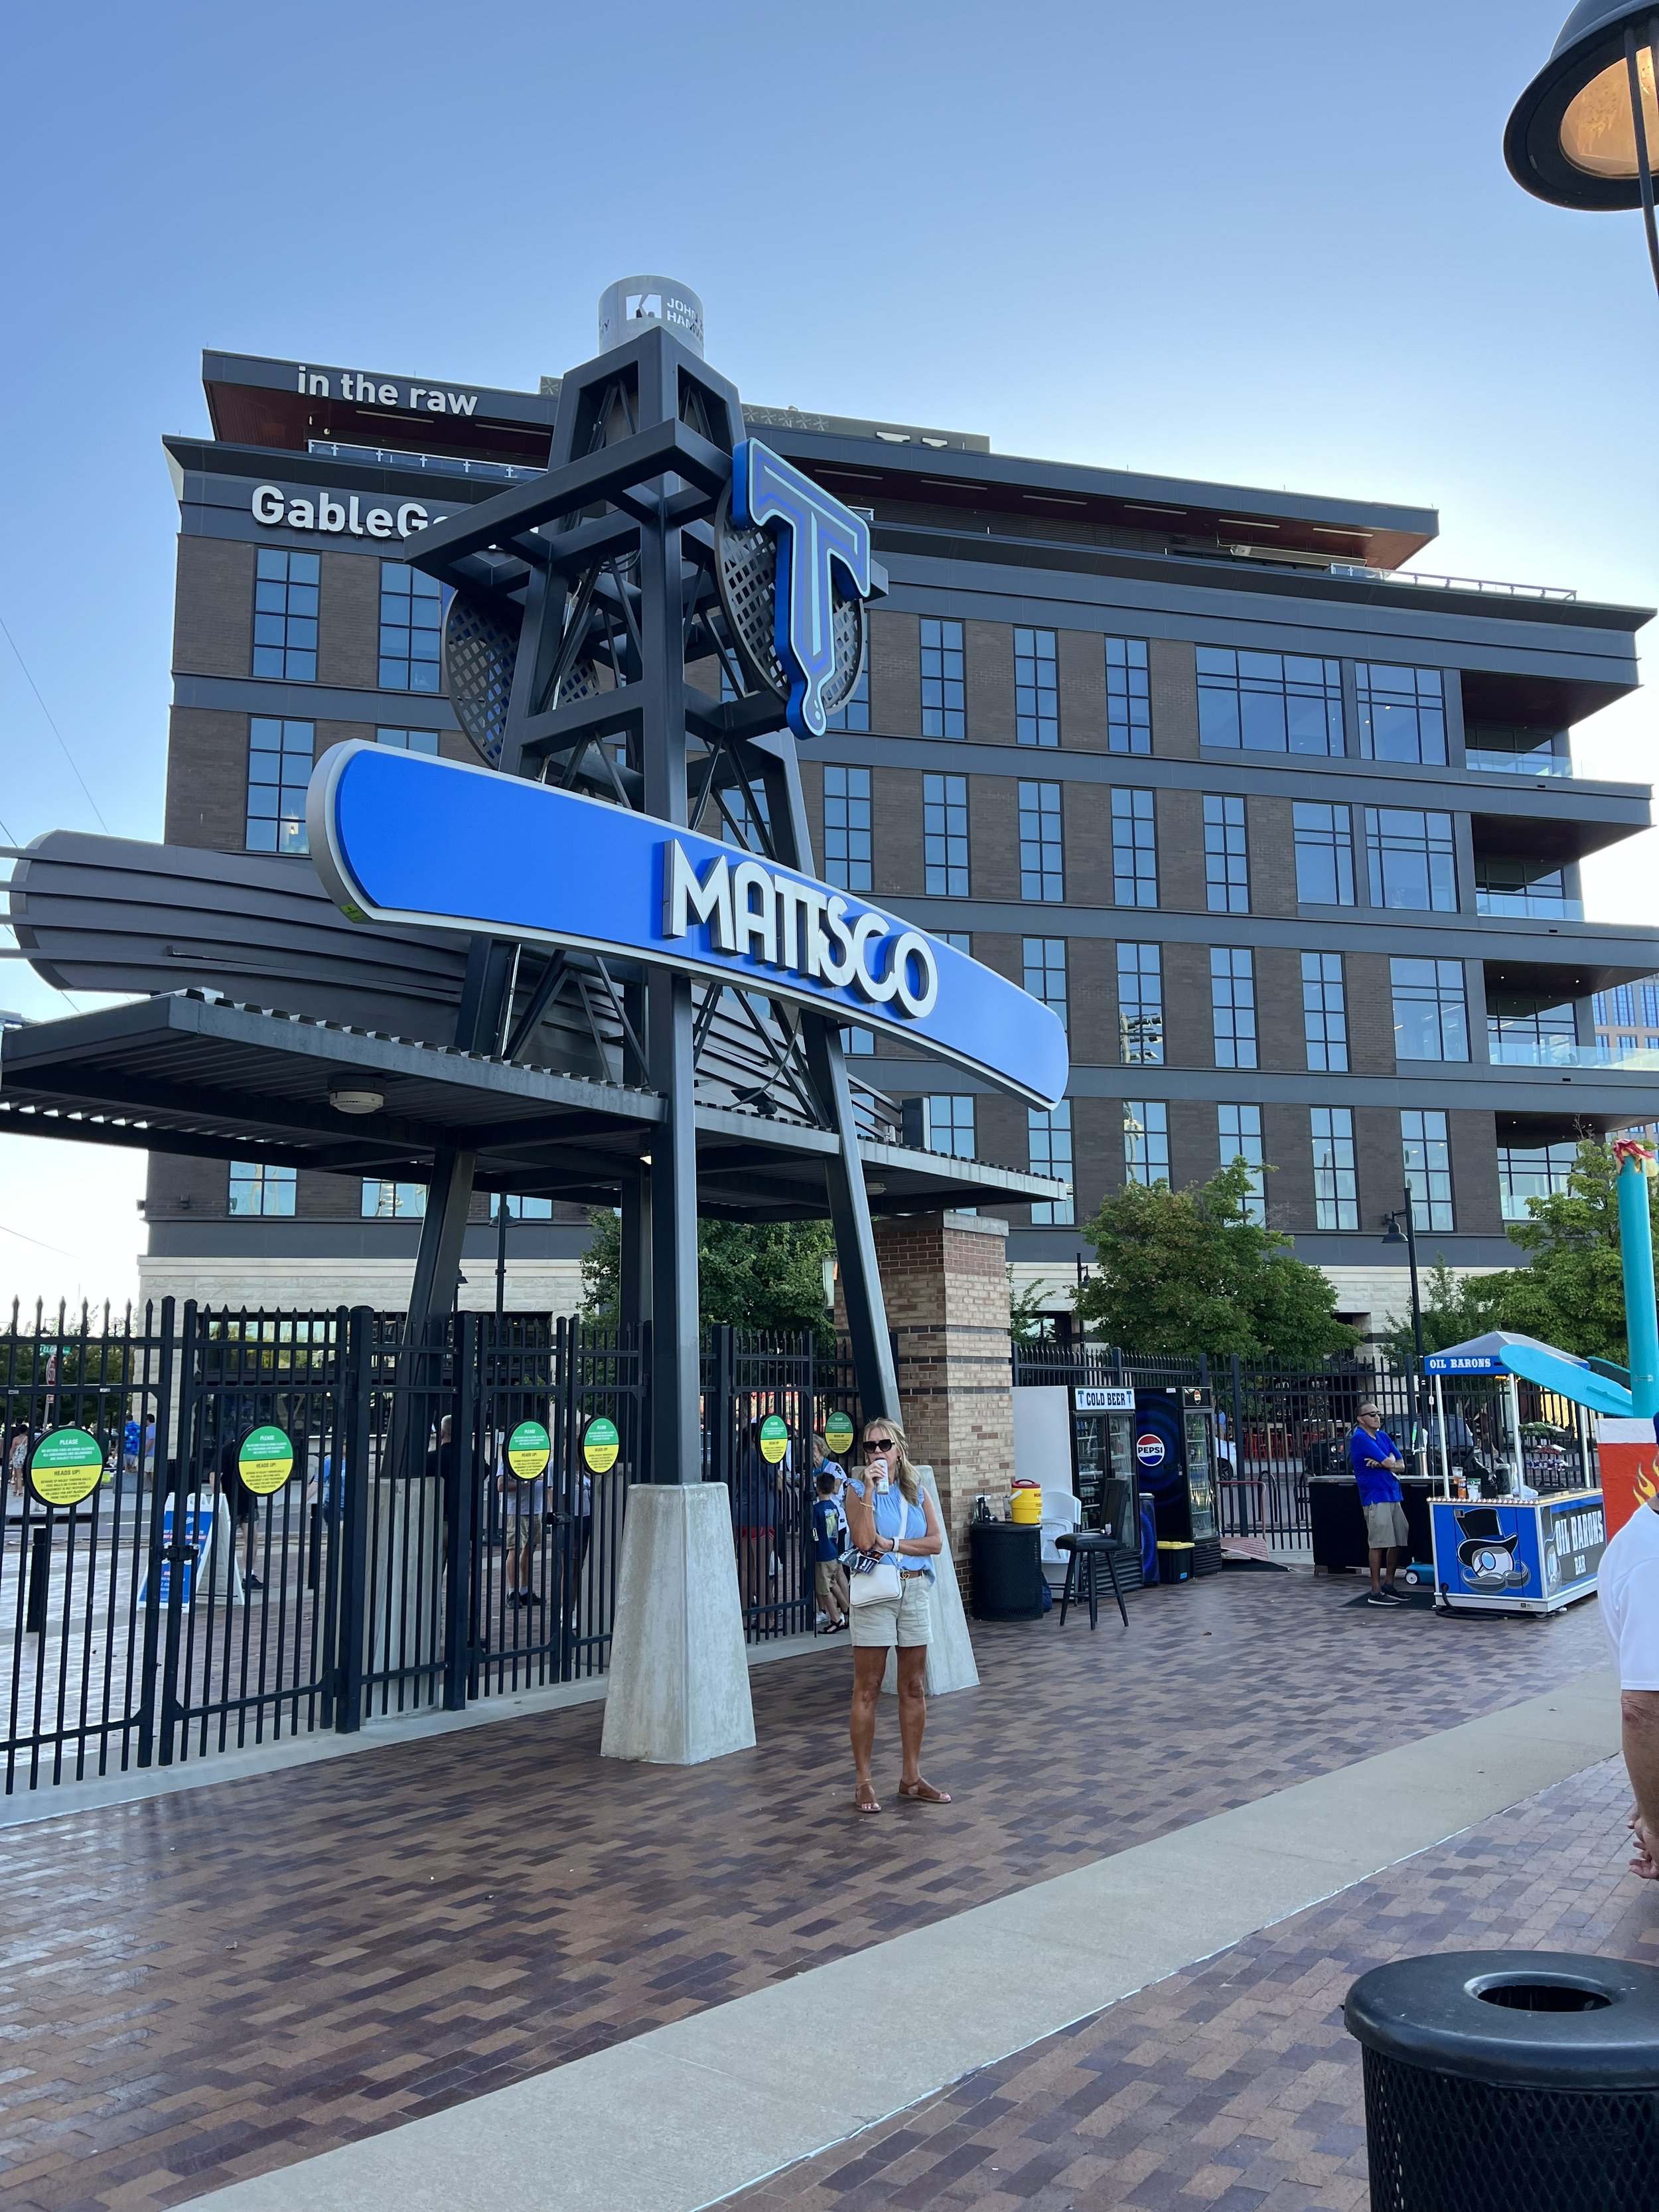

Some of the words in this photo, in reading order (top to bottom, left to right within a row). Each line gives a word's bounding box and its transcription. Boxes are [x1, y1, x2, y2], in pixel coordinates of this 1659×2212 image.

[298, 366, 329, 398] in
[340, 374, 398, 406] the
[409, 388, 478, 416] raw
[251, 484, 449, 538] GableG
[1429, 1359, 1447, 1368] OIL
[1451, 1358, 1491, 1368] BARONS
[1086, 1392, 1105, 1406] COLD
[1107, 1392, 1126, 1406] BEER
[1555, 1518, 1571, 1556] OIL
[1570, 1511, 1604, 1552] BARONS
[1574, 1554, 1587, 1576] BAR
